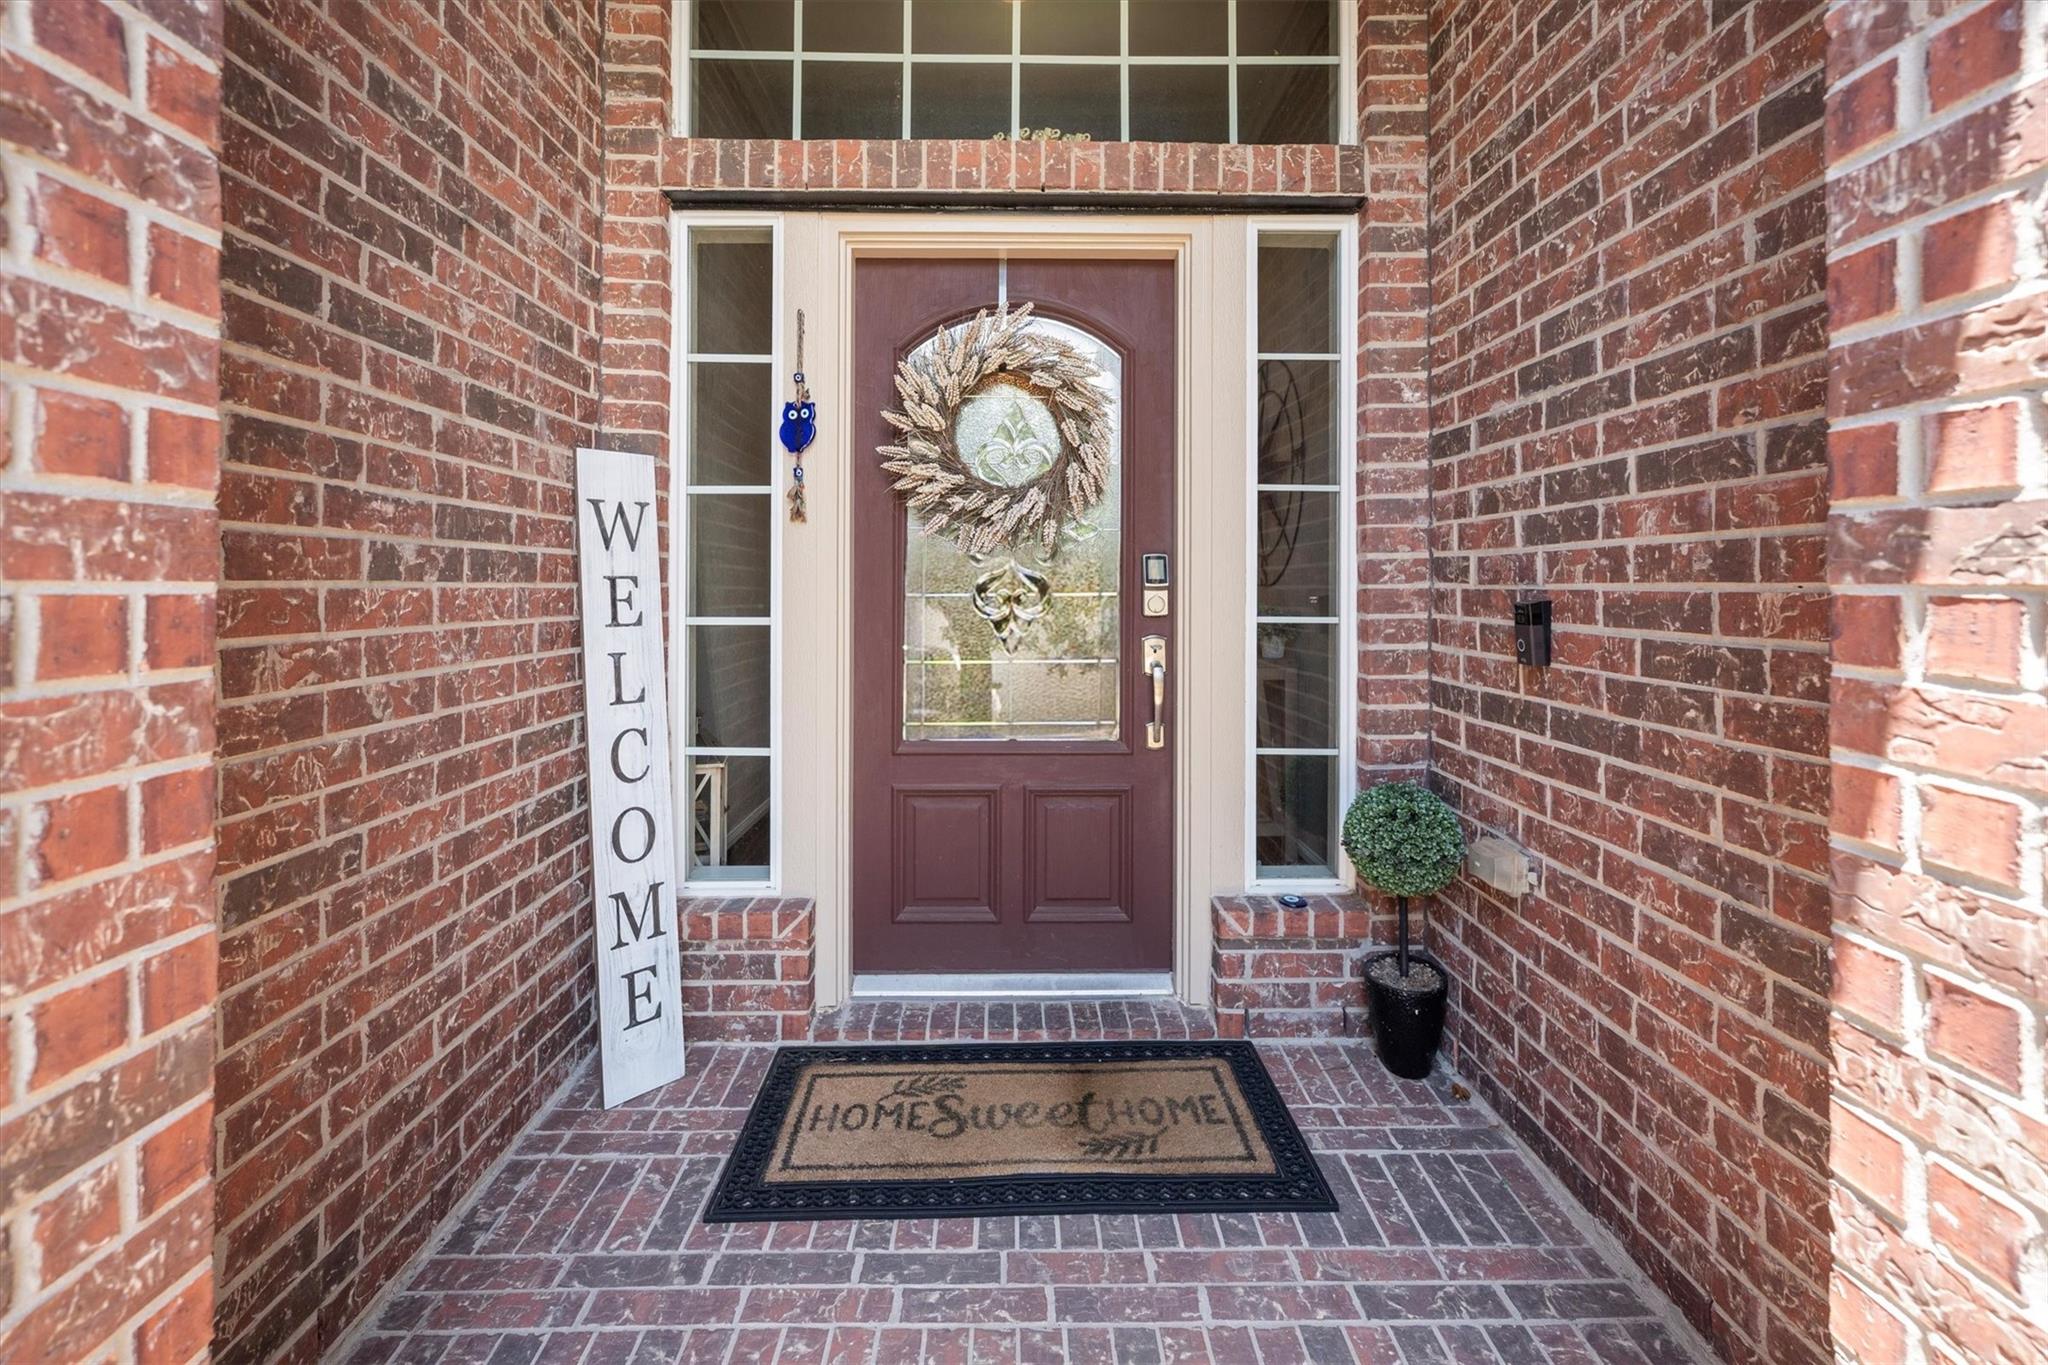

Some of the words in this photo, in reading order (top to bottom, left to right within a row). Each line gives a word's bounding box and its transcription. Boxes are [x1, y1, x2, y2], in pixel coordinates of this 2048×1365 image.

[586, 498, 667, 1032] WELCOME
[809, 1101, 929, 1132] HOME
[928, 1091, 1107, 1139] Sweet
[1106, 1094, 1226, 1126] HOME
